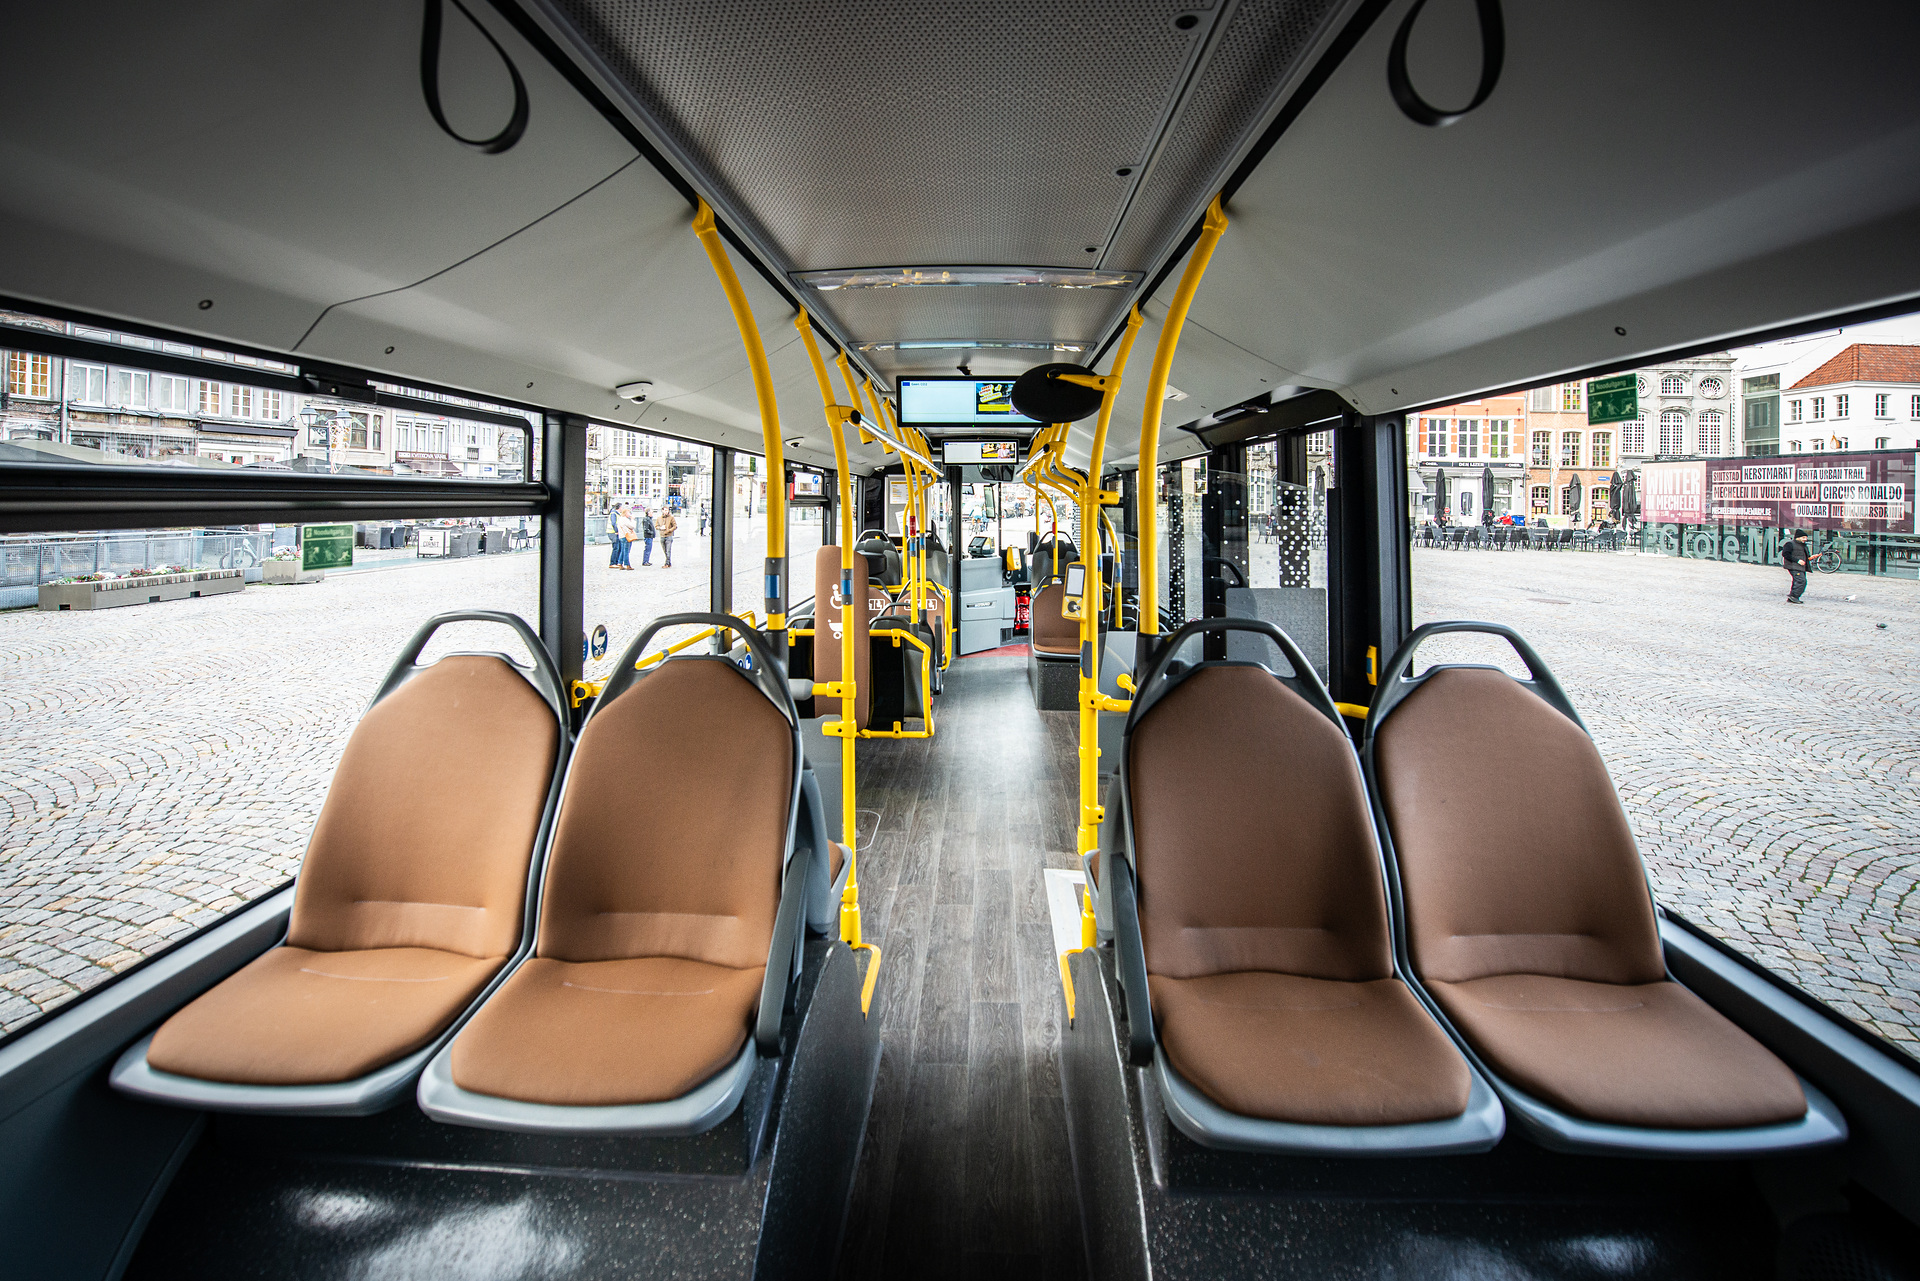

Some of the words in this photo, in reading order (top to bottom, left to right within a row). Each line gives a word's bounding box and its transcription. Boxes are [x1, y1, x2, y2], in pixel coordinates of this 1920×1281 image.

[1744, 466, 1793, 480] KERSTMARKT
[1798, 469, 1818, 480] BRITA
[1819, 469, 1842, 480] URBAN
[1843, 468, 1865, 480] TRAIL
[1646, 468, 1700, 495] WINTER
[1713, 486, 1749, 499] MECHELEN
[1750, 486, 1759, 499] IN
[1760, 486, 1781, 499] VUUR
[1782, 486, 1793, 499] EN
[1794, 486, 1817, 499] VLAM
[1823, 486, 1856, 500] CIRCUS
[1857, 486, 1903, 500] RONALDO
[1645, 495, 1655, 511] IN
[1656, 495, 1700, 511] MECHELEN
[1796, 505, 1827, 516] OUDJAAR
[1660, 523, 1740, 562] Grote
